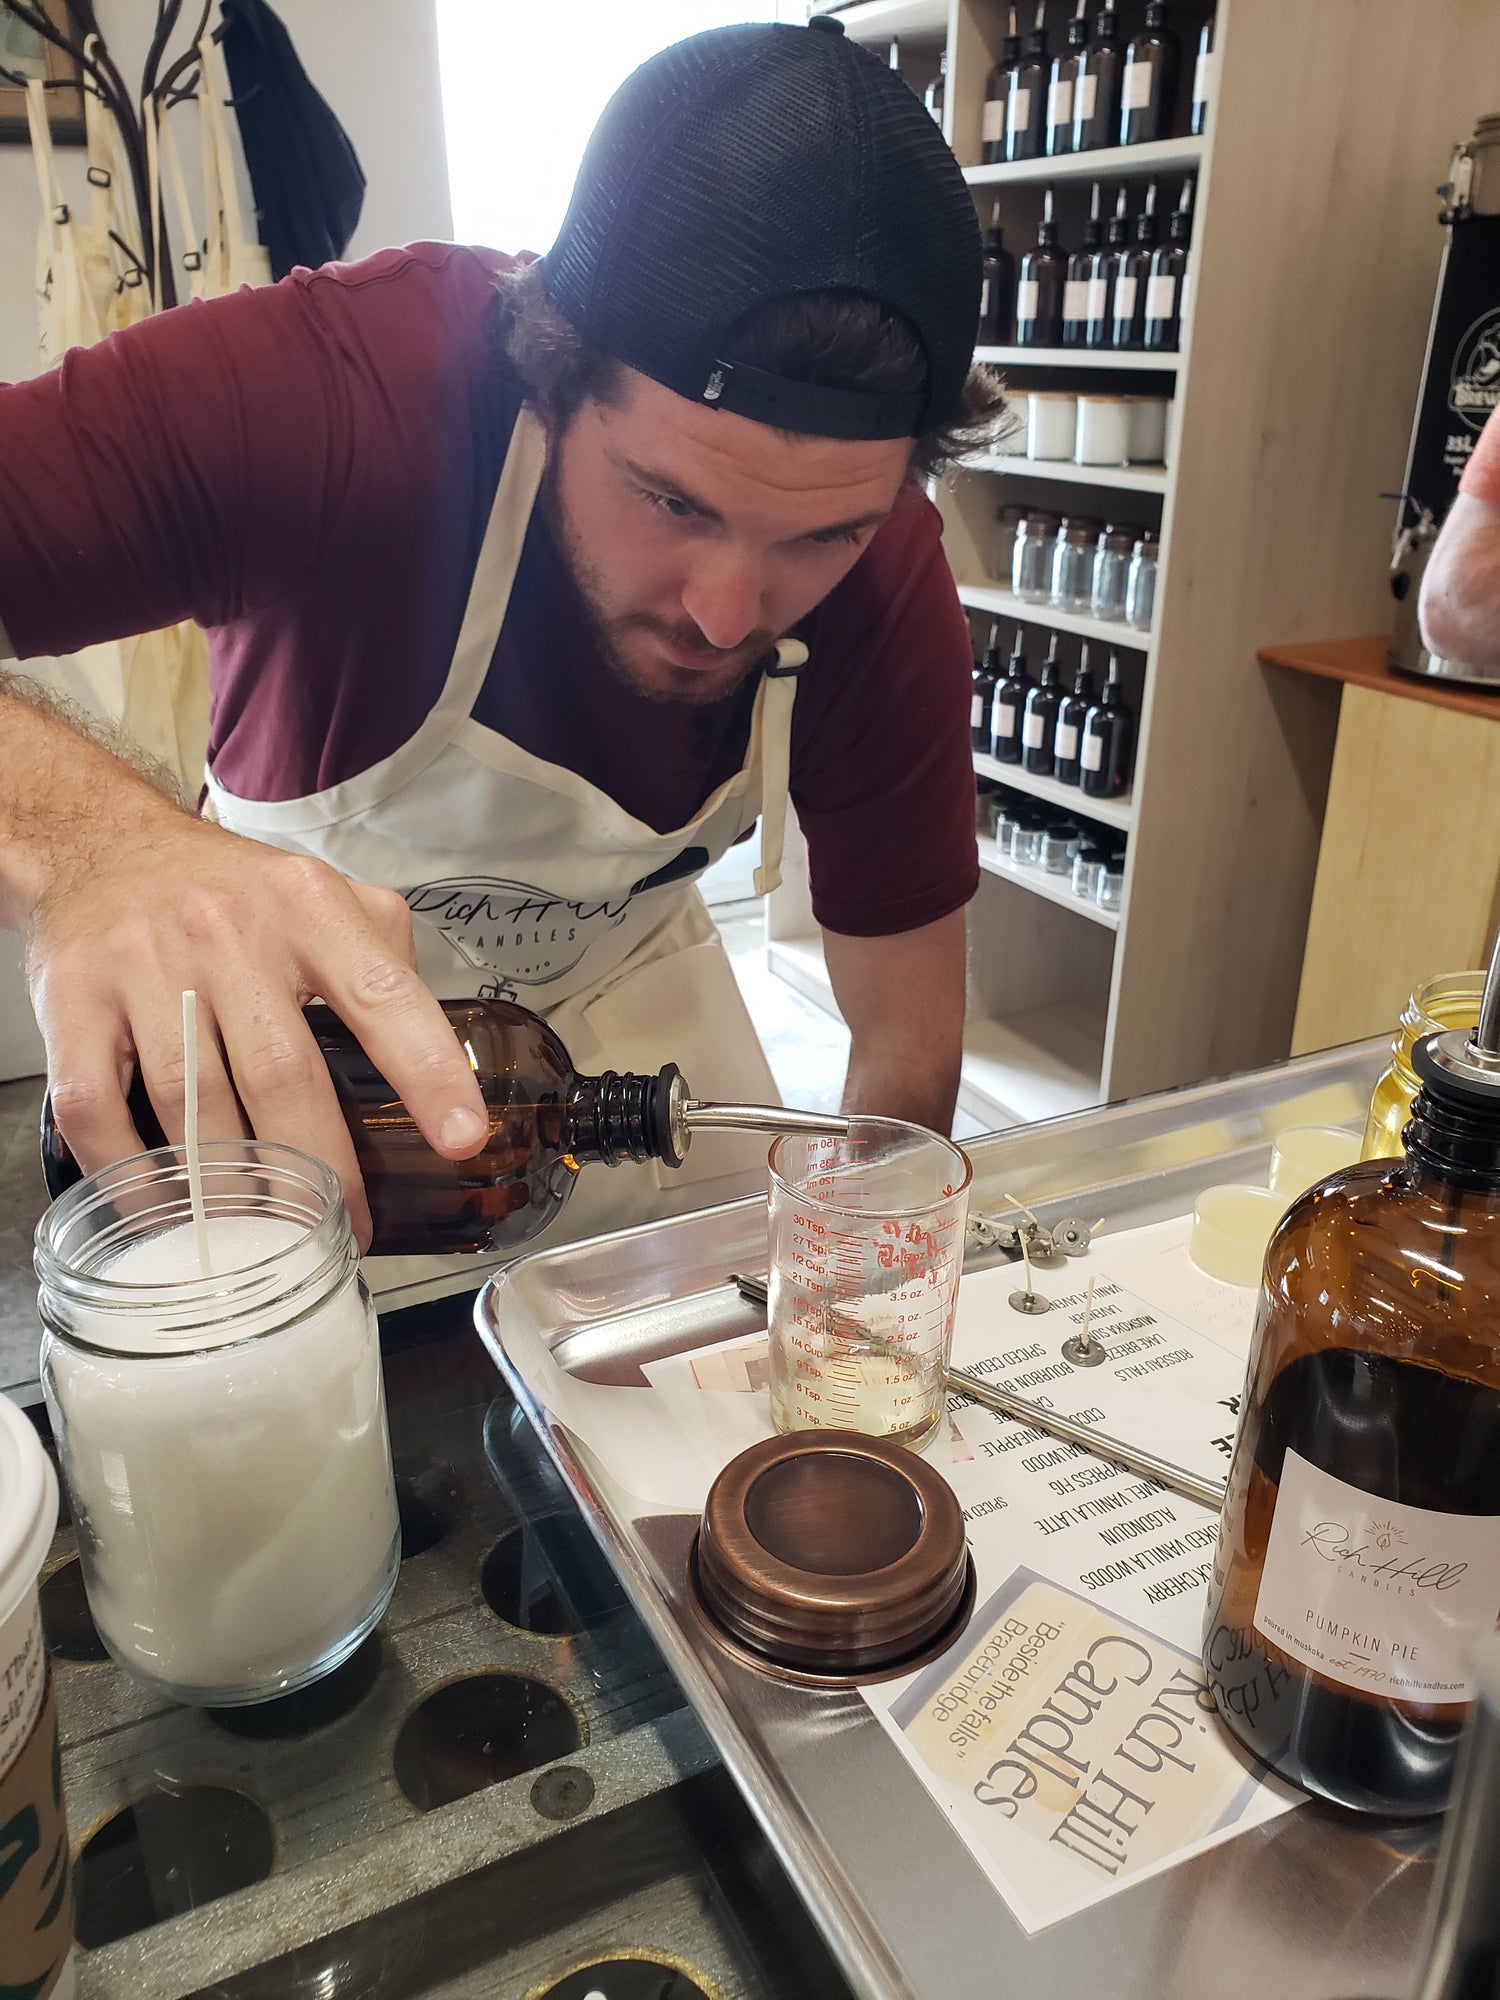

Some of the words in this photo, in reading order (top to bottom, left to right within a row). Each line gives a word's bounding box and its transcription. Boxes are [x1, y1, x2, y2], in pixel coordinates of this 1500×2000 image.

[793, 1214, 804, 1226] 30
[793, 1233, 803, 1245] 27
[792, 1252, 803, 1266] 1/2
[792, 1271, 803, 1284] 21
[890, 1292, 907, 1302] 3.5
[910, 1289, 924, 1299] oz.
[898, 1314, 906, 1324] 3
[908, 1312, 922, 1322] oz.
[1106, 1315, 1158, 1336] MUSKOKA
[791, 1336, 802, 1350] 1/4
[804, 1343, 823, 1359] Cup
[906, 1331, 920, 1342] oz.
[1136, 1333, 1167, 1348] LAKE
[1002, 1343, 1047, 1366] SPICED
[1104, 1341, 1142, 1361] BREEZE
[1145, 1348, 1194, 1372] ROSSEAU
[804, 1364, 823, 1379] Tsp.
[885, 1375, 900, 1385] 1.5
[1013, 1361, 1075, 1389] BOURBON
[1114, 1364, 1149, 1382] FALLS
[796, 1383, 802, 1393] 6
[803, 1387, 823, 1402] Tsp.
[900, 1395, 914, 1405] oz.
[796, 1407, 802, 1416] 3
[803, 1411, 822, 1426] Tsp.
[978, 1428, 1050, 1458] PINEAPPLE
[1070, 1459, 1130, 1489] CYPRESS
[1048, 1478, 1076, 1496] FIG
[970, 1497, 1008, 1518] SPICED
[1072, 1491, 1133, 1521] VANILLA
[1033, 1510, 1079, 1536] LATTE
[1098, 1506, 1177, 1546] ALGONQUIN
[1129, 1539, 1192, 1570] VANILLA
[1300, 1522, 1367, 1567] Rich
[1369, 1557, 1469, 1591] Hill
[1079, 1560, 1137, 1590] WOODS
[1337, 1565, 1416, 1597] CANDLES
[1142, 1571, 1200, 1605] CHERRY
[1306, 1609, 1381, 1653] PUMPKIN
[1391, 1642, 1419, 1661] PIE
[1263, 1615, 1284, 1637] poured
[1293, 1635, 1326, 1661] muskoka
[1354, 1665, 1387, 1682] 1970
[932, 1617, 1029, 1723] Bracebridge
[984, 1675, 1017, 1711] the
[973, 1635, 1153, 1820] Candles
[1113, 1668, 1219, 1775] Rich
[1049, 1768, 1156, 1876] Hill
